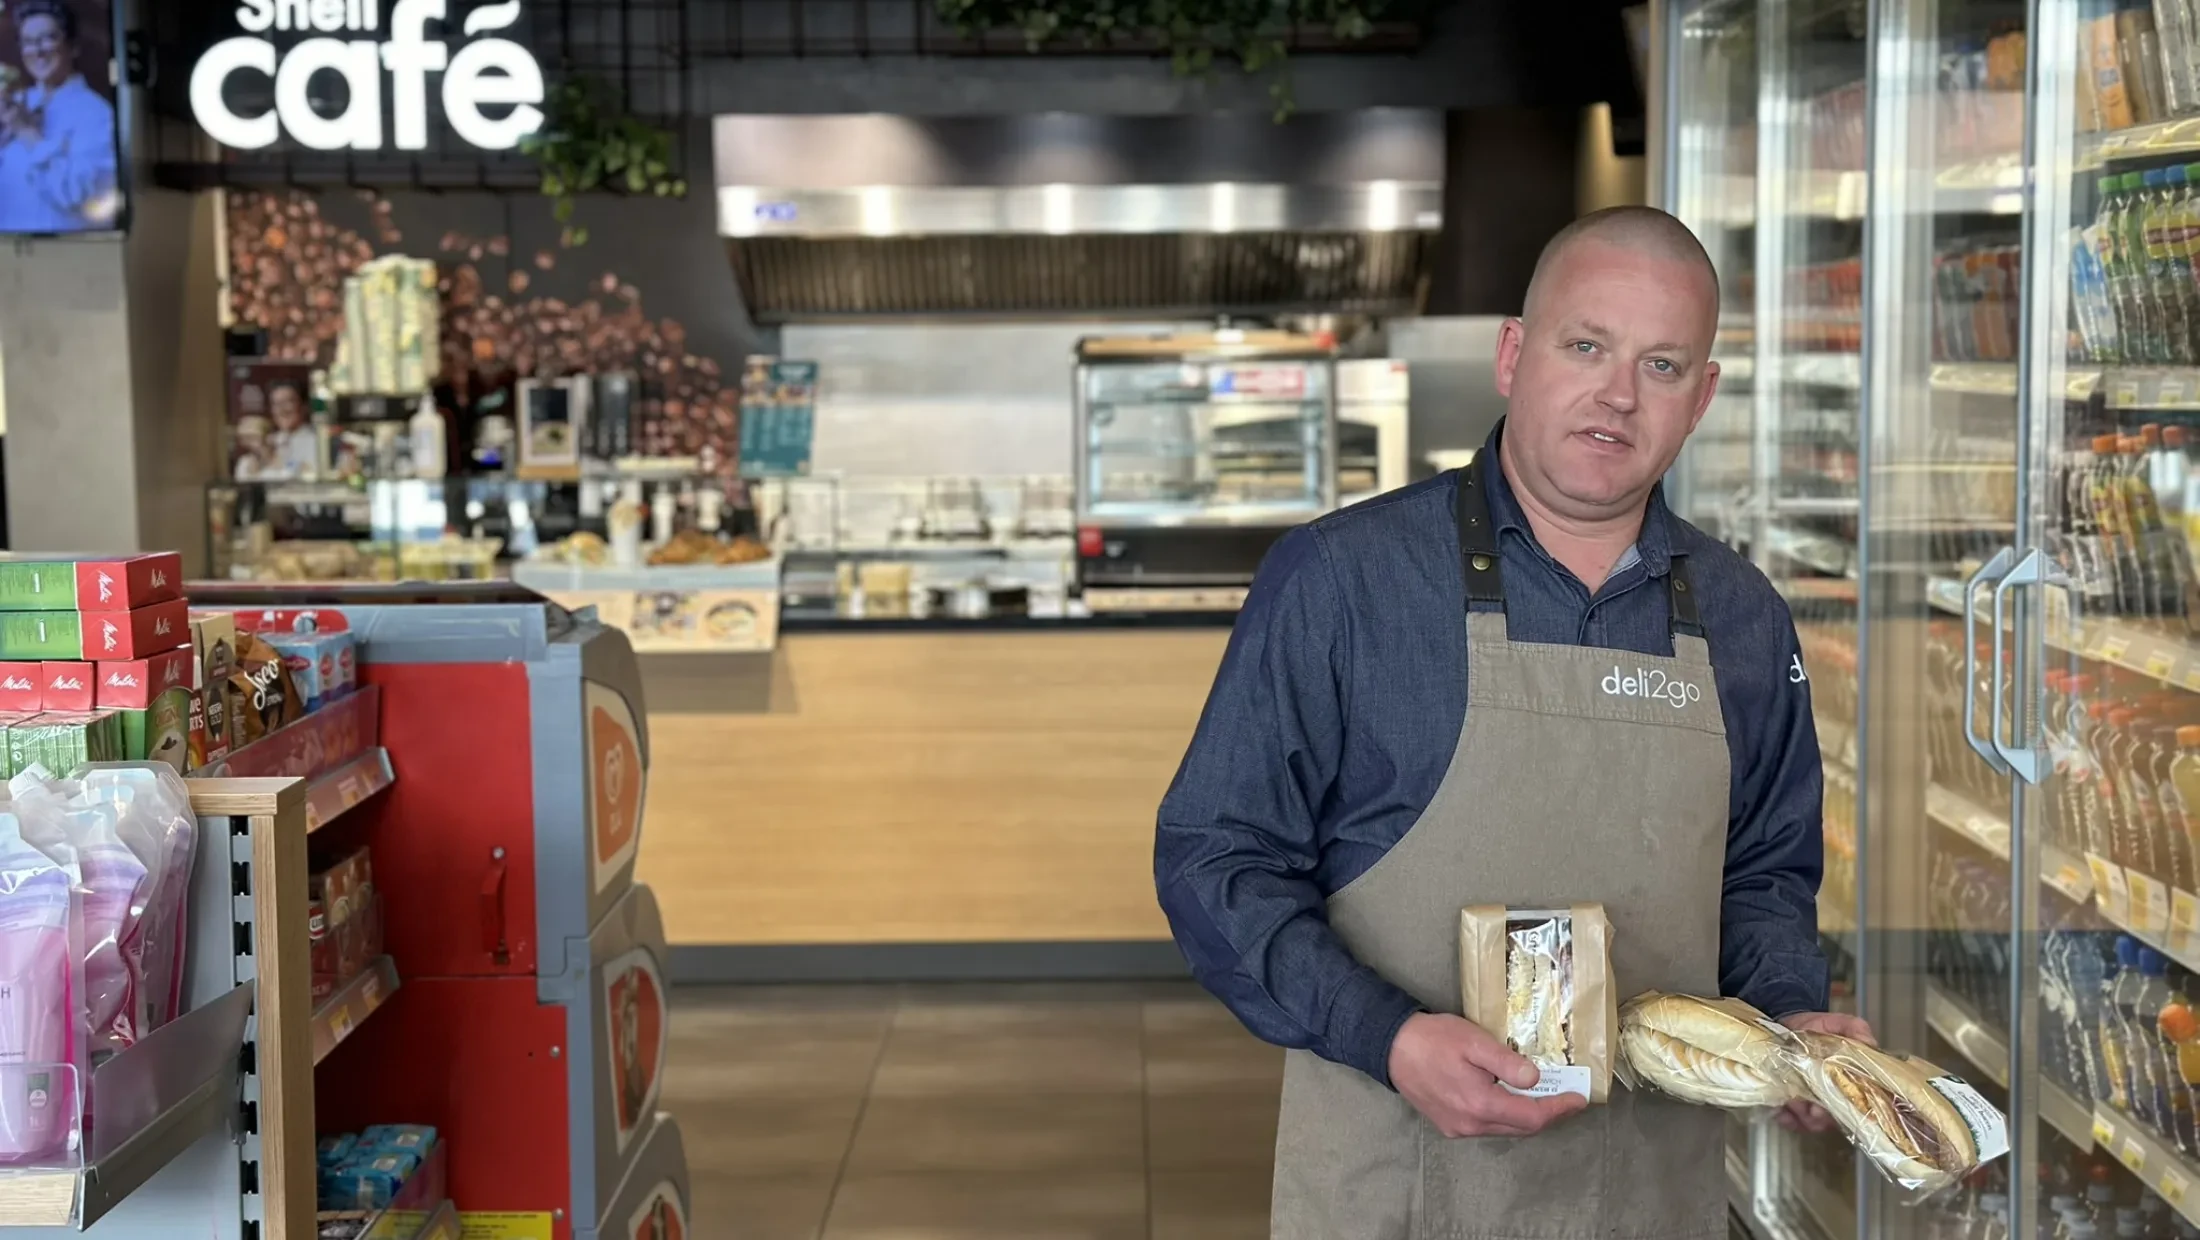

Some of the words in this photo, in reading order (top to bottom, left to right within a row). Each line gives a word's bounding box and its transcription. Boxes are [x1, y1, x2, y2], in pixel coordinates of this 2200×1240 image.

[236, 0, 379, 32] Shell
[189, 0, 545, 150] café
[1601, 665, 1701, 708] deli2go
